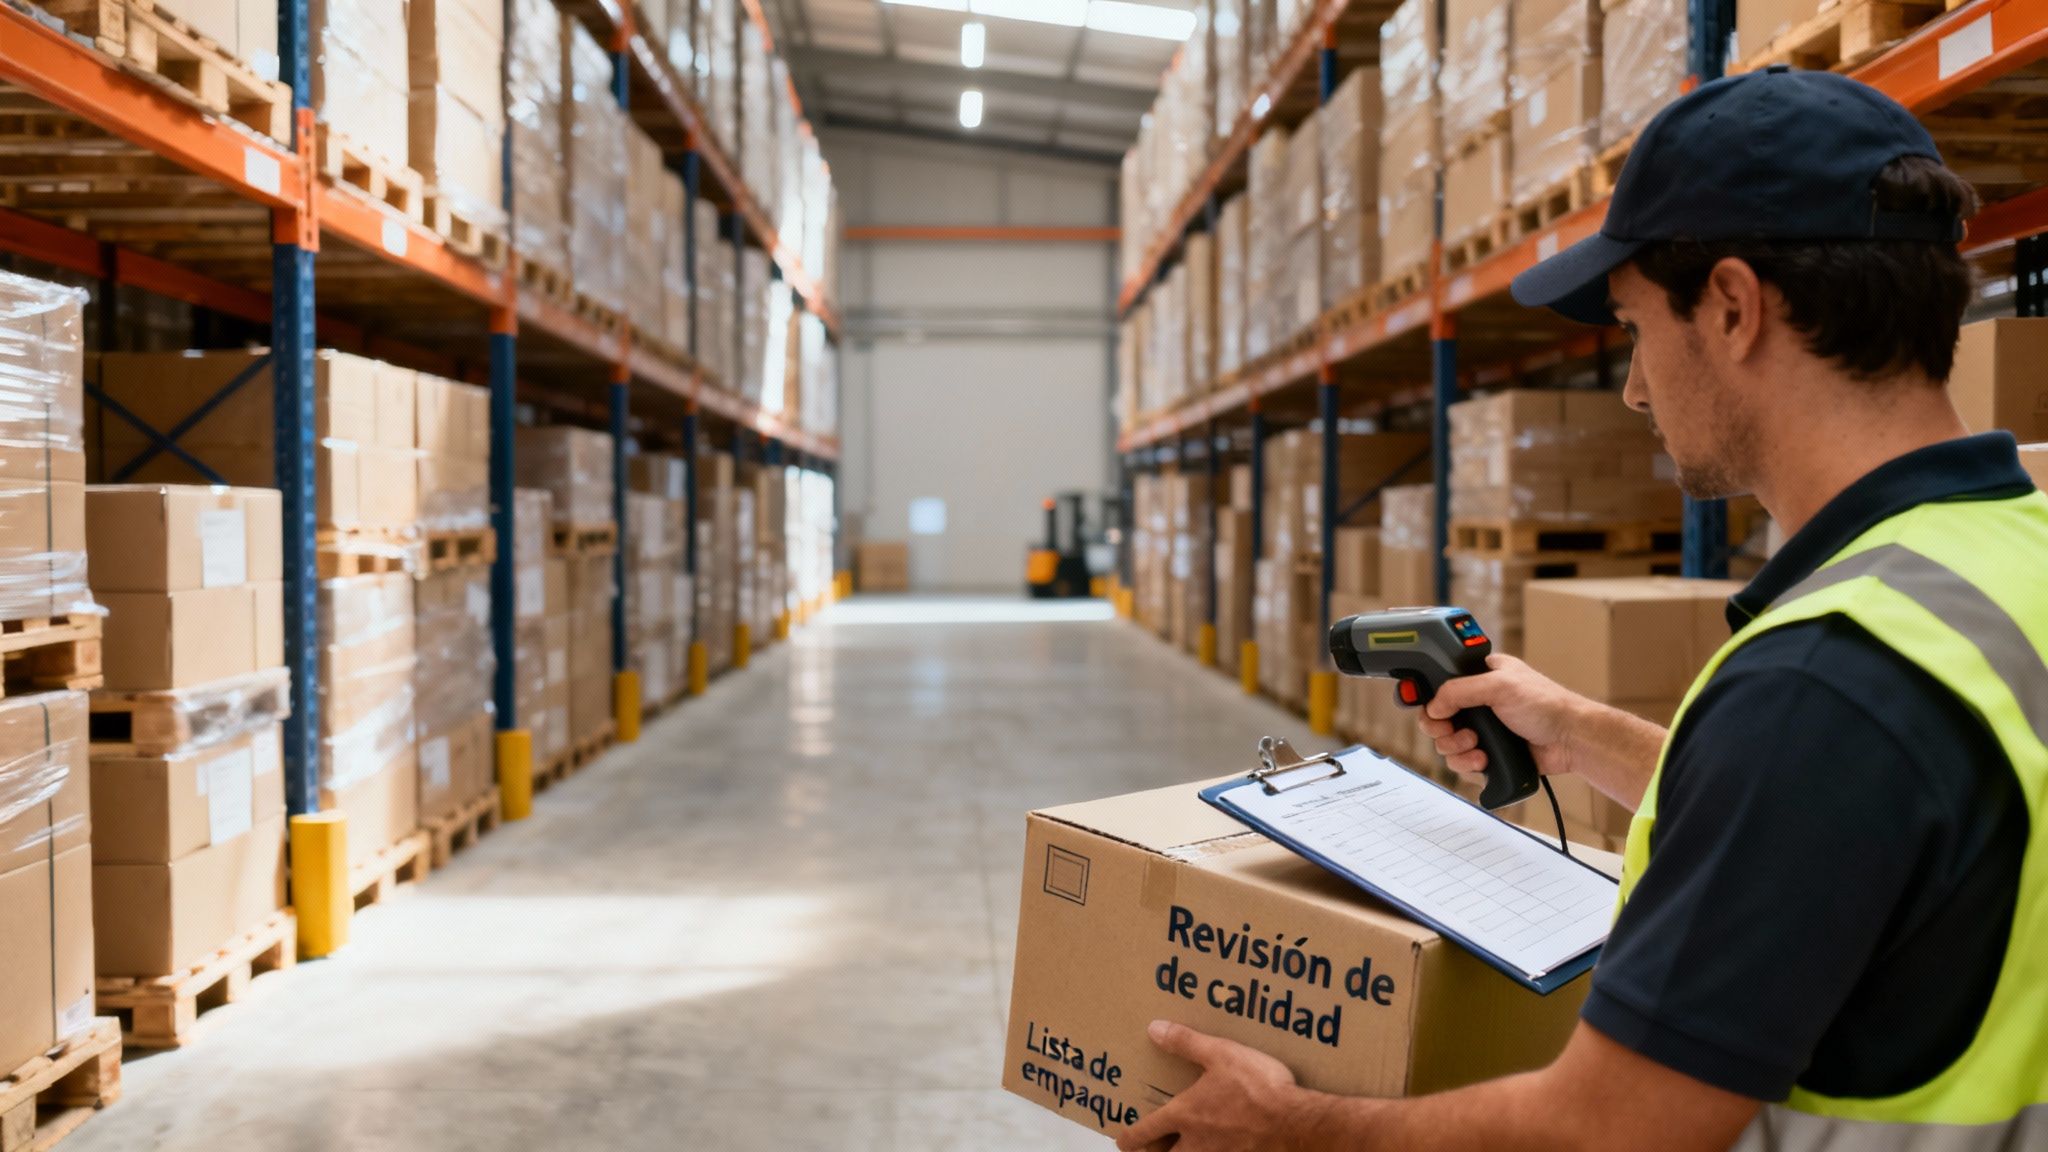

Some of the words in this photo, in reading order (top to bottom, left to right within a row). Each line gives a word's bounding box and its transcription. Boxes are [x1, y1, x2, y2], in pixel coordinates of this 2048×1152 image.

[1155, 955, 1198, 999] de
[1206, 979, 1342, 1047] calidad
[1344, 956, 1395, 1006] de
[1027, 1021, 1084, 1070] Lista
[1090, 1051, 1122, 1087] de
[1022, 1058, 1140, 1128] empaque
